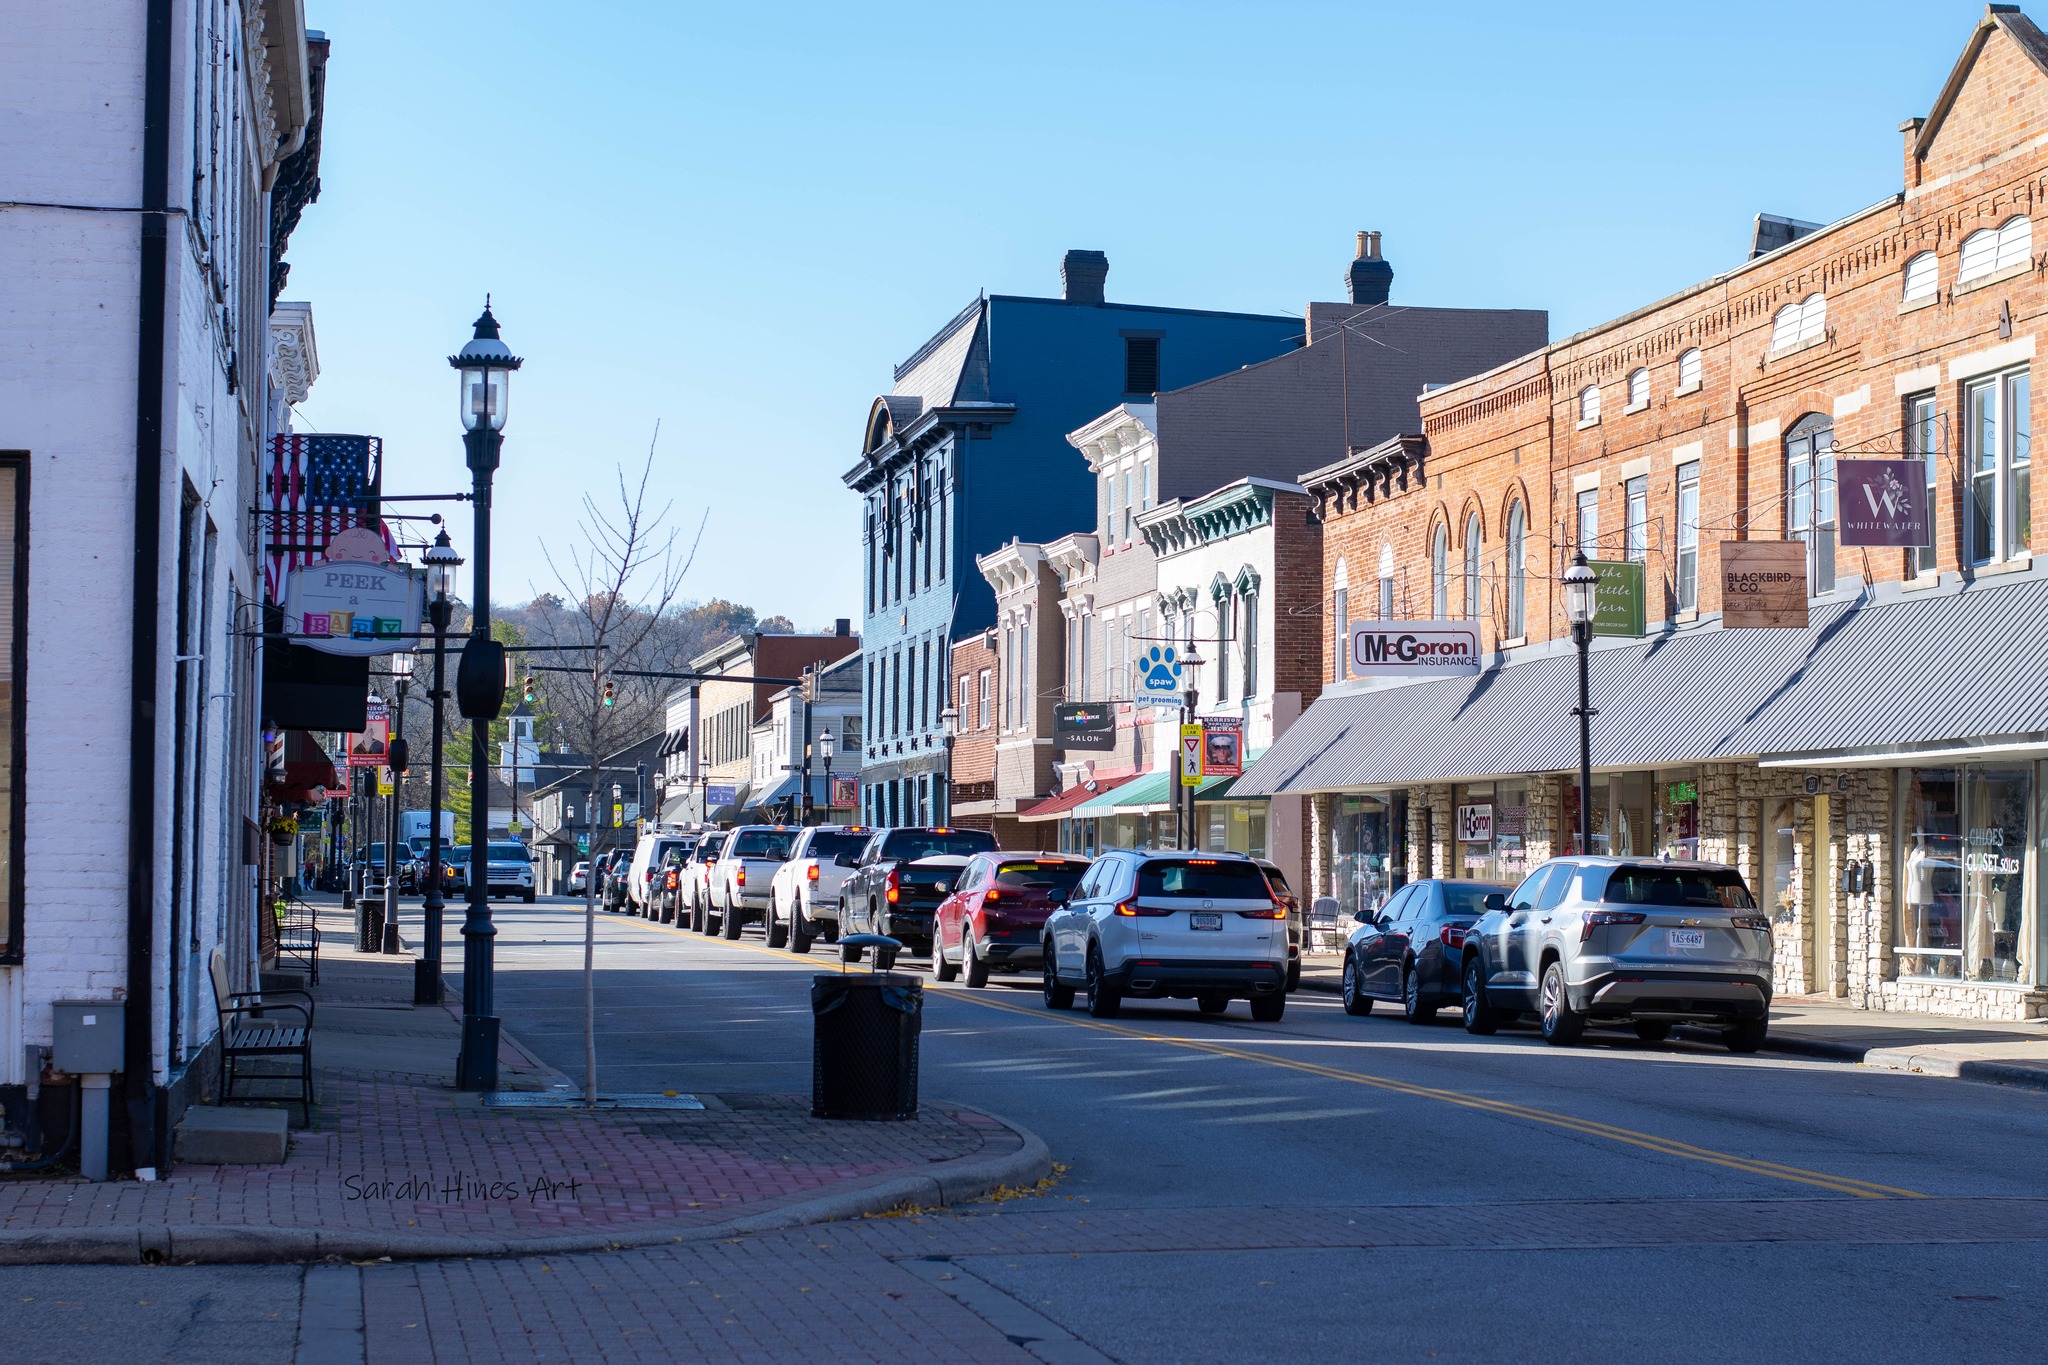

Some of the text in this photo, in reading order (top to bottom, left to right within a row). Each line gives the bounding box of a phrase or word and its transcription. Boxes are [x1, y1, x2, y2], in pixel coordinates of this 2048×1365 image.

[1862, 483, 1900, 519] W
[1847, 521, 1921, 530] WHITEWATER
[1601, 566, 1623, 578] the
[1727, 572, 1792, 583] BLACKBIRD
[324, 572, 387, 591] PEEK
[1727, 582, 1762, 593] & CO.
[1595, 584, 1631, 596] little
[349, 595, 359, 605] a
[1595, 601, 1627, 616] fern
[321, 614, 399, 634] BABY
[1364, 634, 1468, 662] McGoron
[1418, 656, 1478, 666] INSURANCE
[1149, 678, 1173, 687] spaw
[1151, 697, 1182, 706] grooming
[1070, 734, 1099, 742] SALON
[1460, 807, 1491, 839] McGoron
[1969, 827, 2004, 847] CHLOES
[1966, 852, 1999, 872] CLOSET
[1671, 933, 1703, 944] TAS-6487
